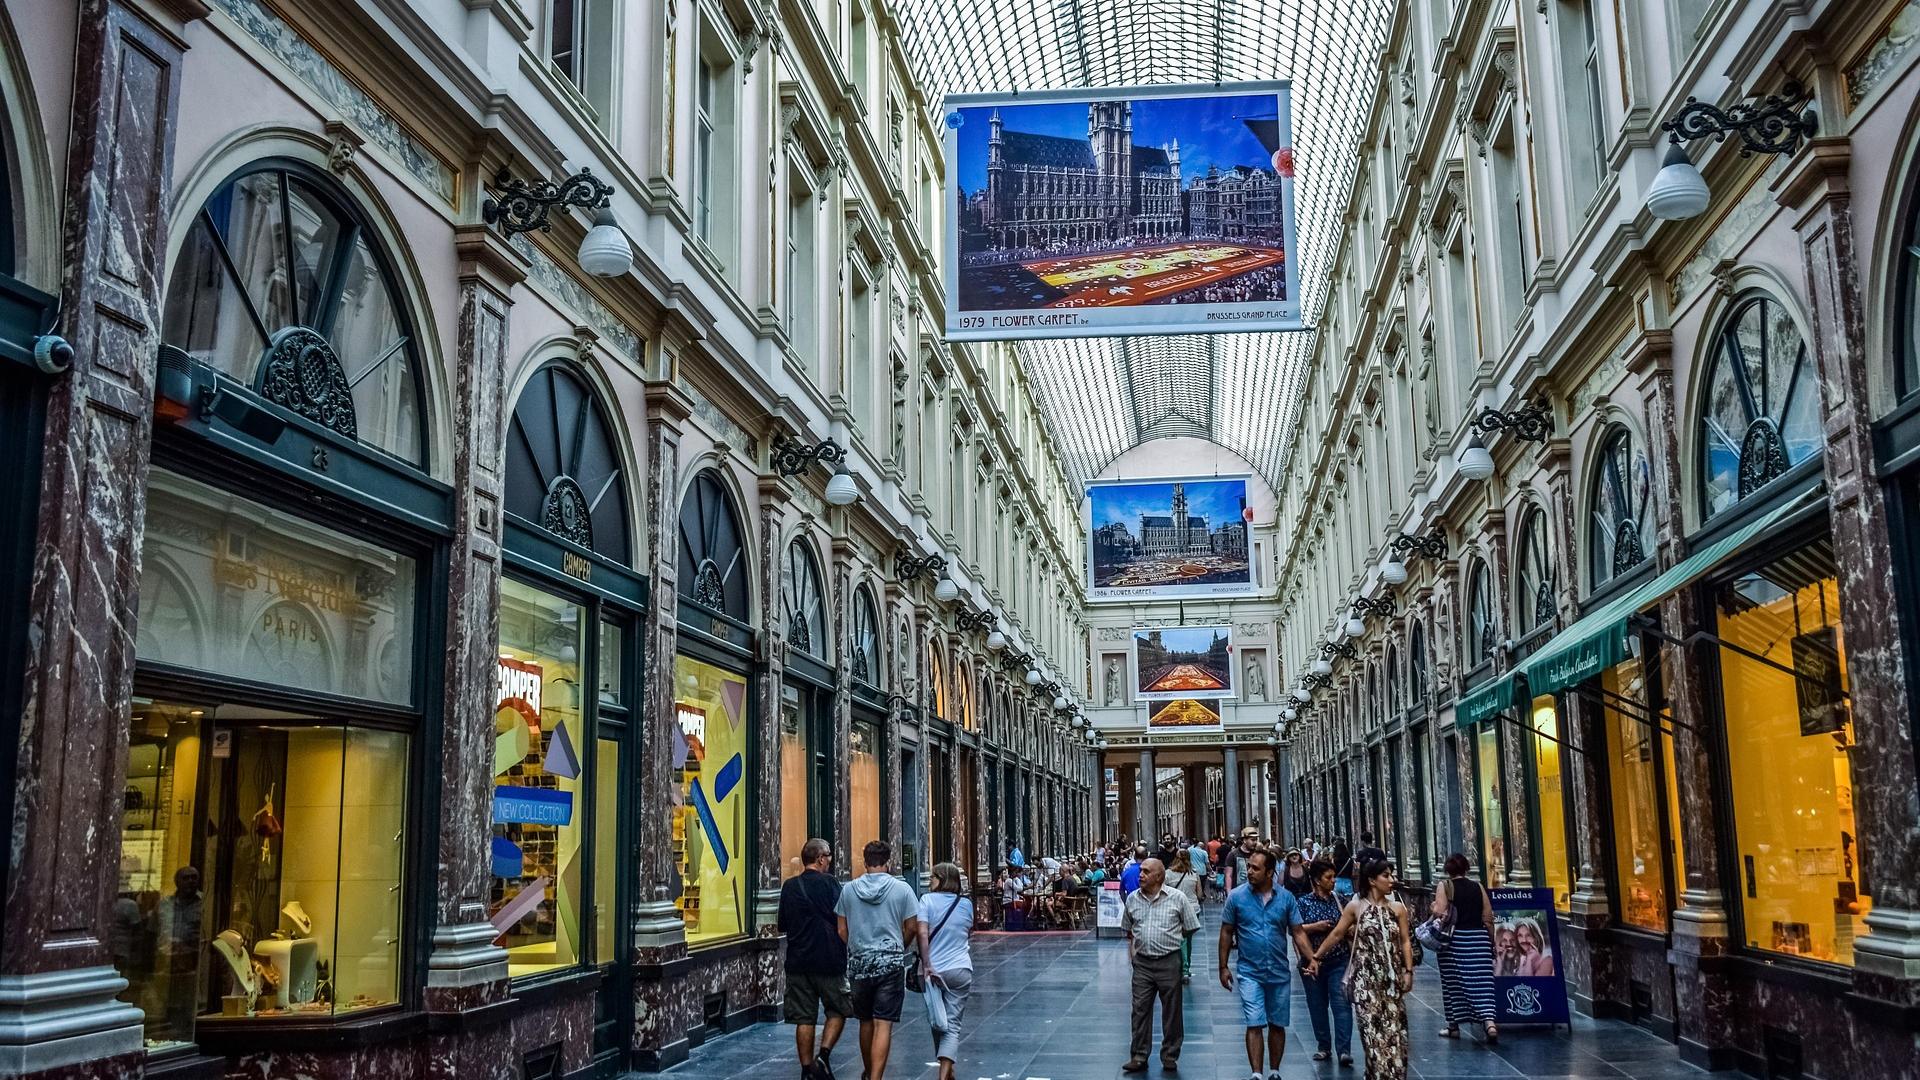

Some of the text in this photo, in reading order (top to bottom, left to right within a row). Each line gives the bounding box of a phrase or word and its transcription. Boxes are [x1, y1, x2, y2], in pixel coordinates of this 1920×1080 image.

[959, 317, 985, 328] 1979
[992, 315, 1035, 327] FLOWER
[1207, 311, 1240, 320] BRUSSELS
[563, 550, 592, 582] CAMPER
[1110, 588, 1132, 596] FLOWER
[263, 613, 319, 643] PARIS
[711, 618, 729, 640] CAMPER
[498, 802, 565, 822] NEW COLLECTION
[1491, 891, 1533, 900] Leonidas
